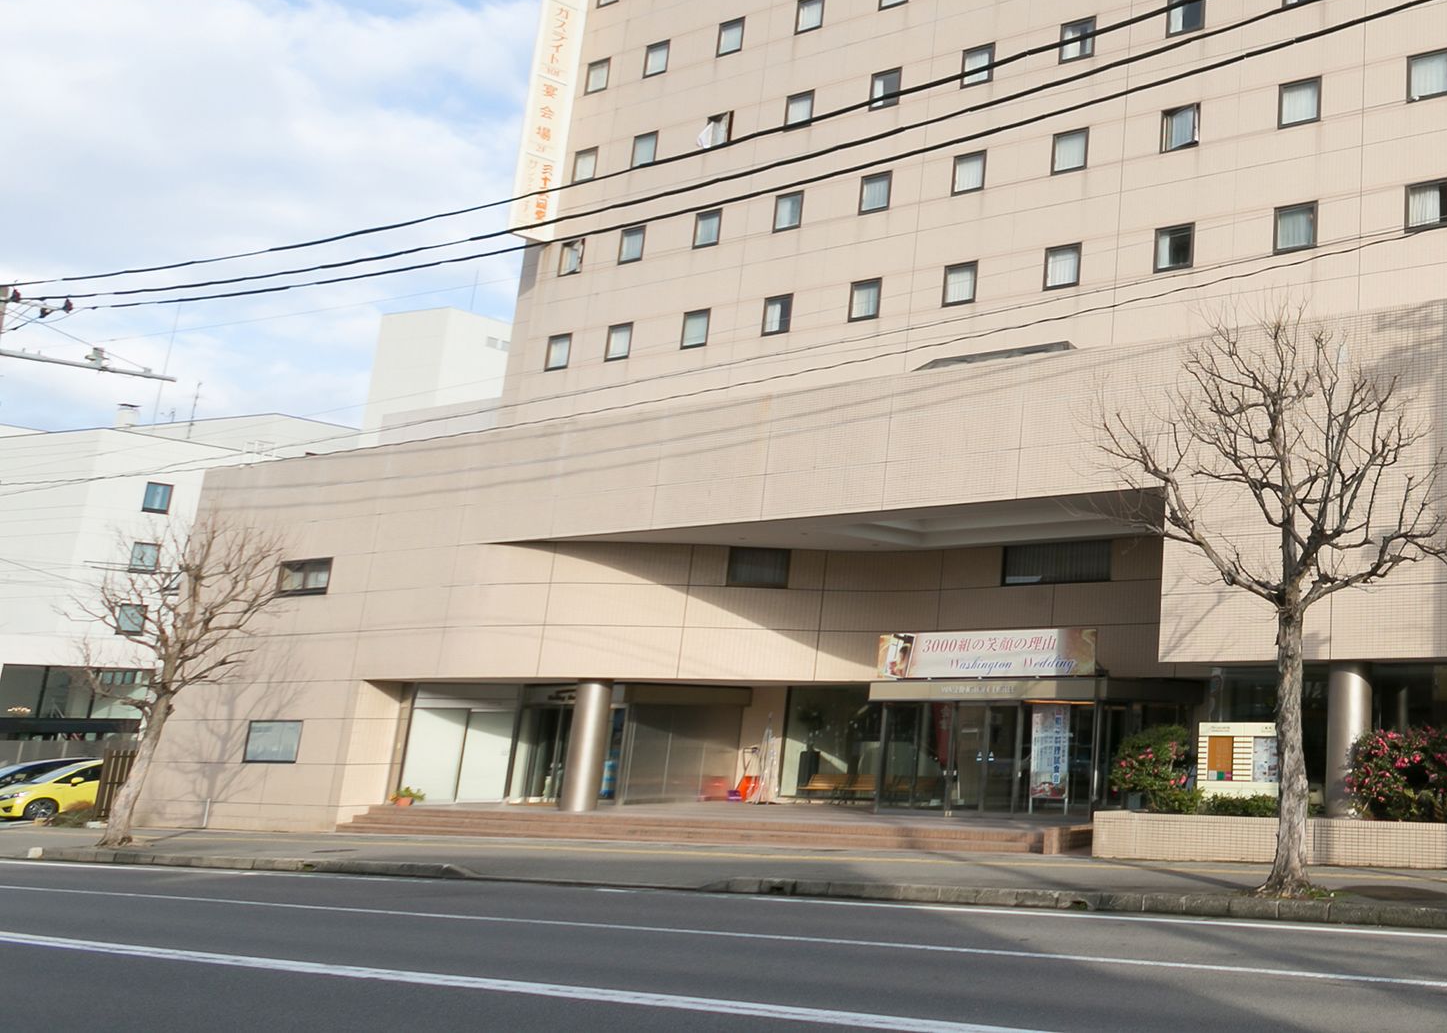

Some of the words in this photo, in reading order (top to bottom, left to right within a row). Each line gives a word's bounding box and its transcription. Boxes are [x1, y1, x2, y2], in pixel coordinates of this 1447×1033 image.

[536, 84, 558, 142] 宴会場
[922, 635, 1057, 653] 3000組の笑顔の理由
[950, 655, 1013, 675] Washington
[1023, 654, 1076, 673] Wedding
